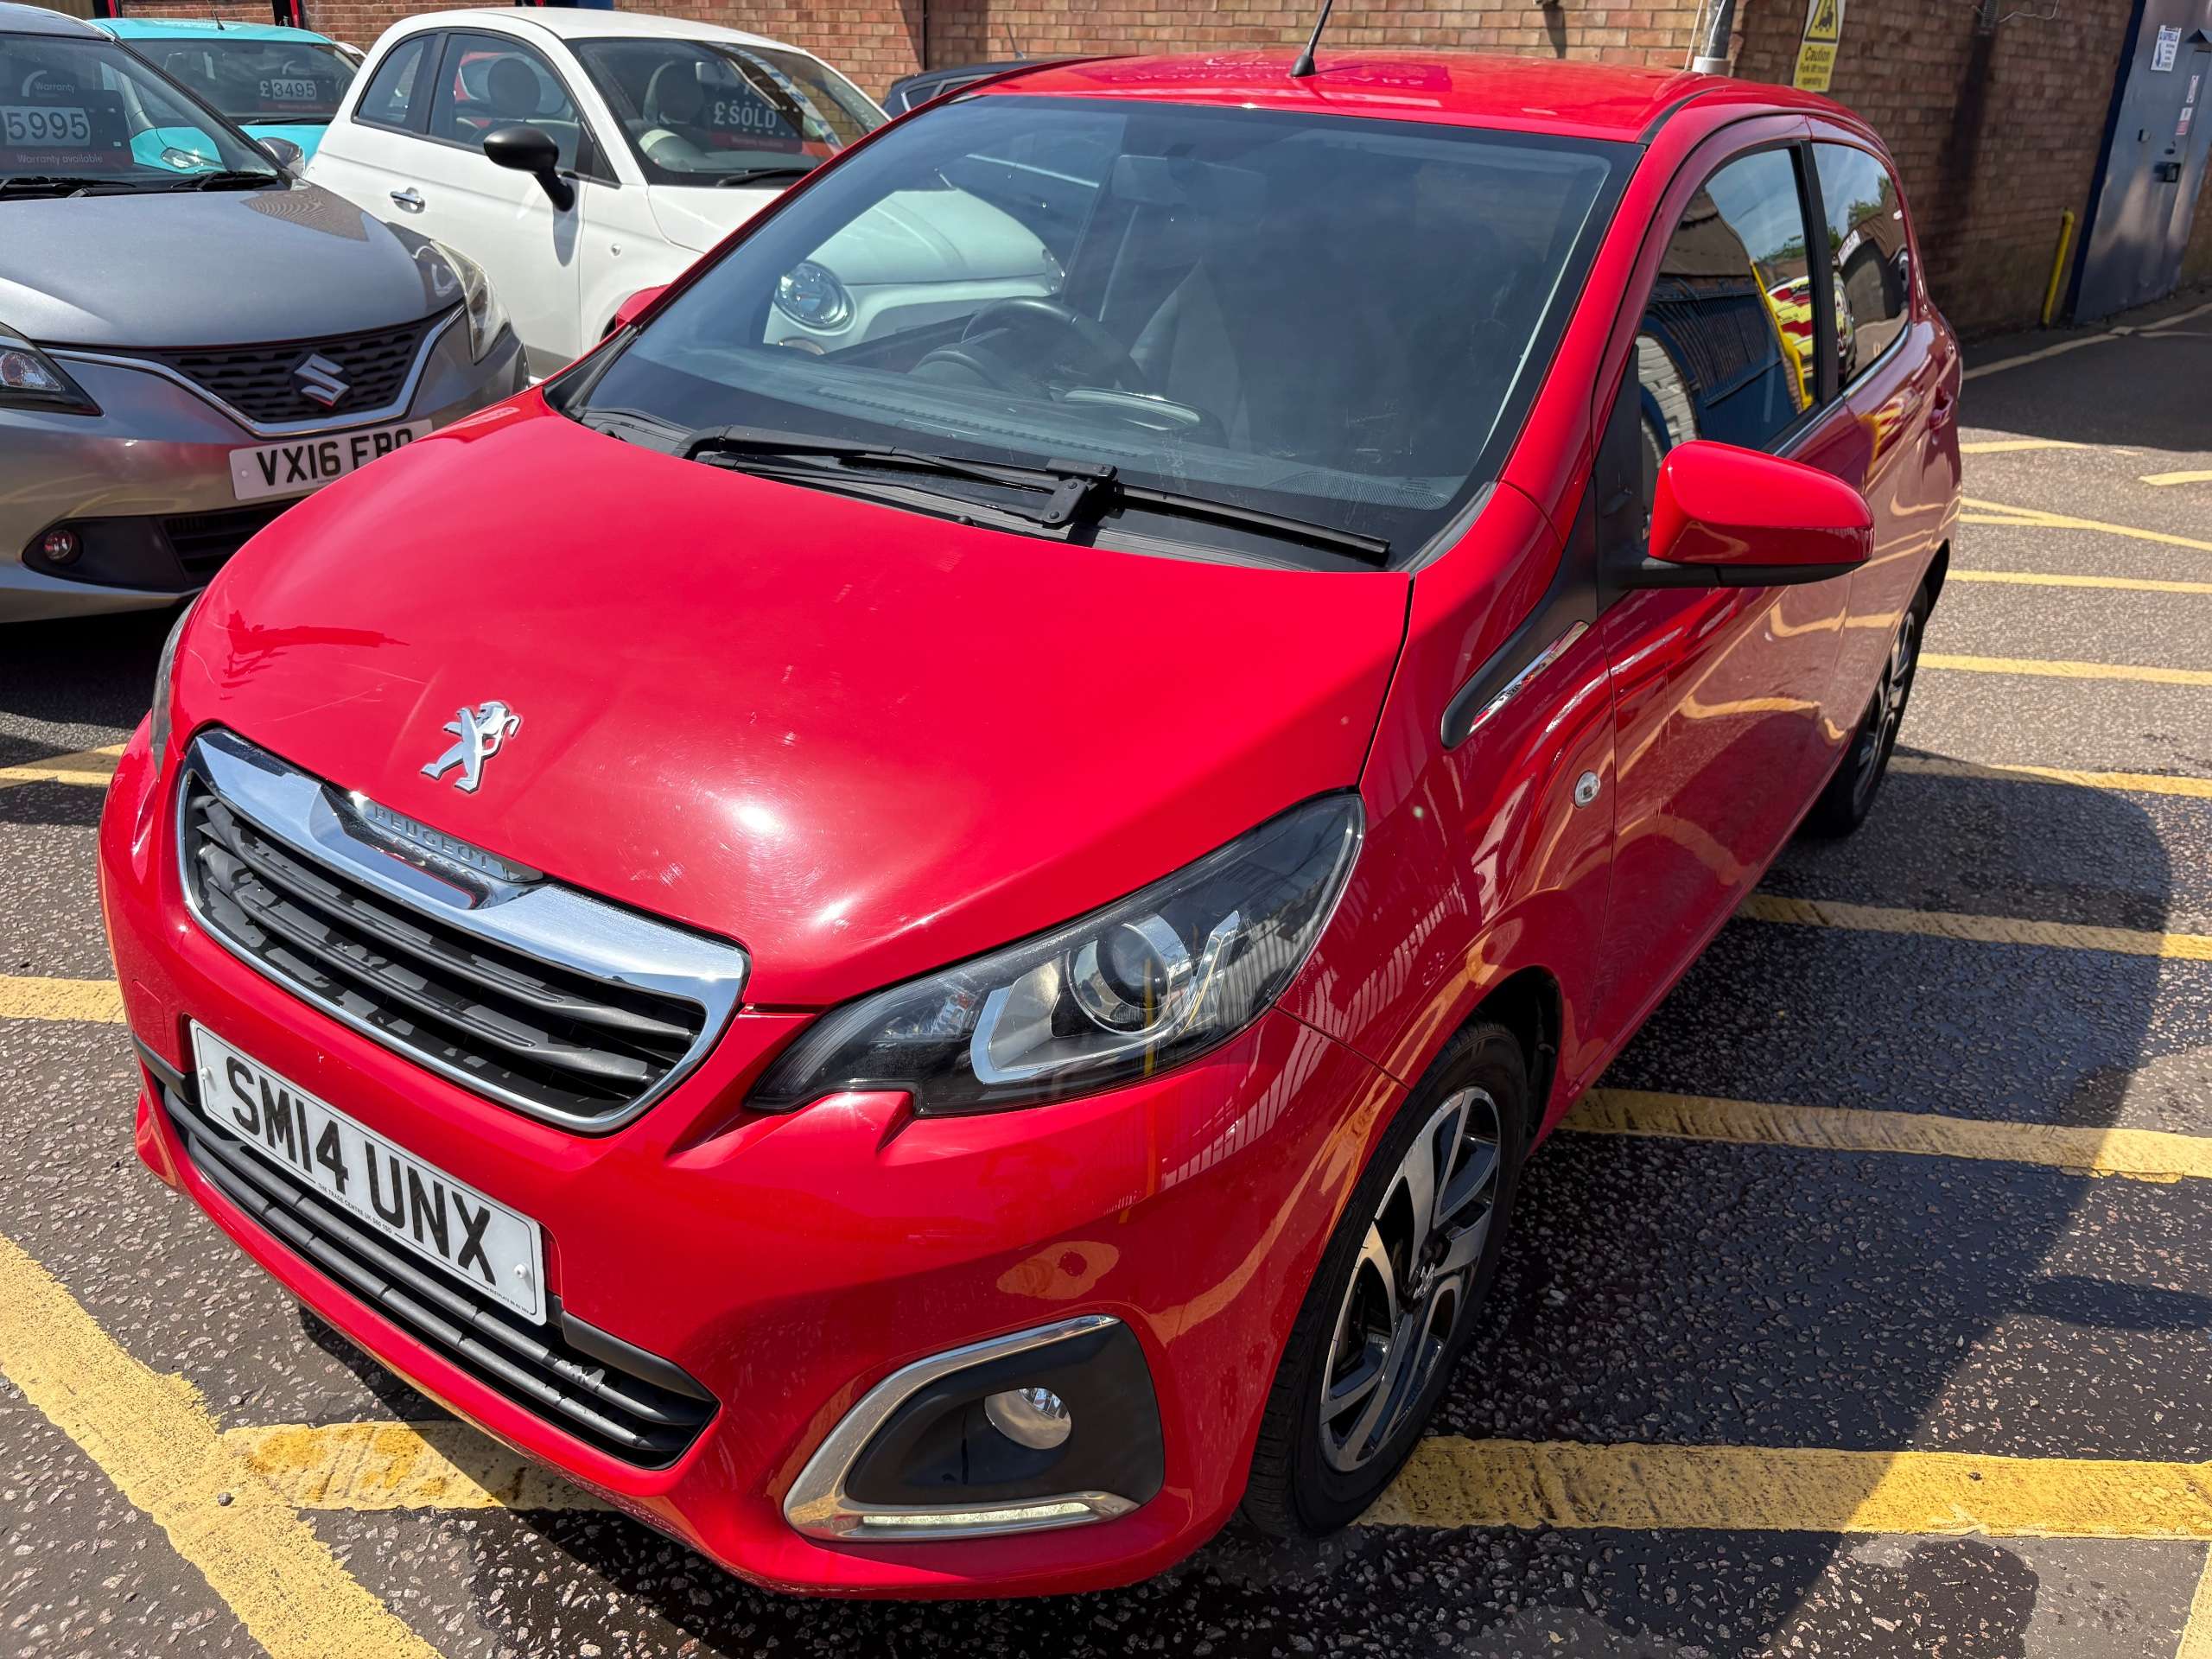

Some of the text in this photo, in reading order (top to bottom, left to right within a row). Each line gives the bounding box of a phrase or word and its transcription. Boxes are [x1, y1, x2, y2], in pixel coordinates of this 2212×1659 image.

[35, 82, 75, 94] Warranty
[260, 80, 316, 98] £3495
[6, 111, 88, 140] 5995
[17, 155, 104, 166] Warranty available
[257, 441, 341, 486] VX16
[374, 804, 491, 868] PEUGEOT
[226, 1055, 497, 1287] SM14 UNX
